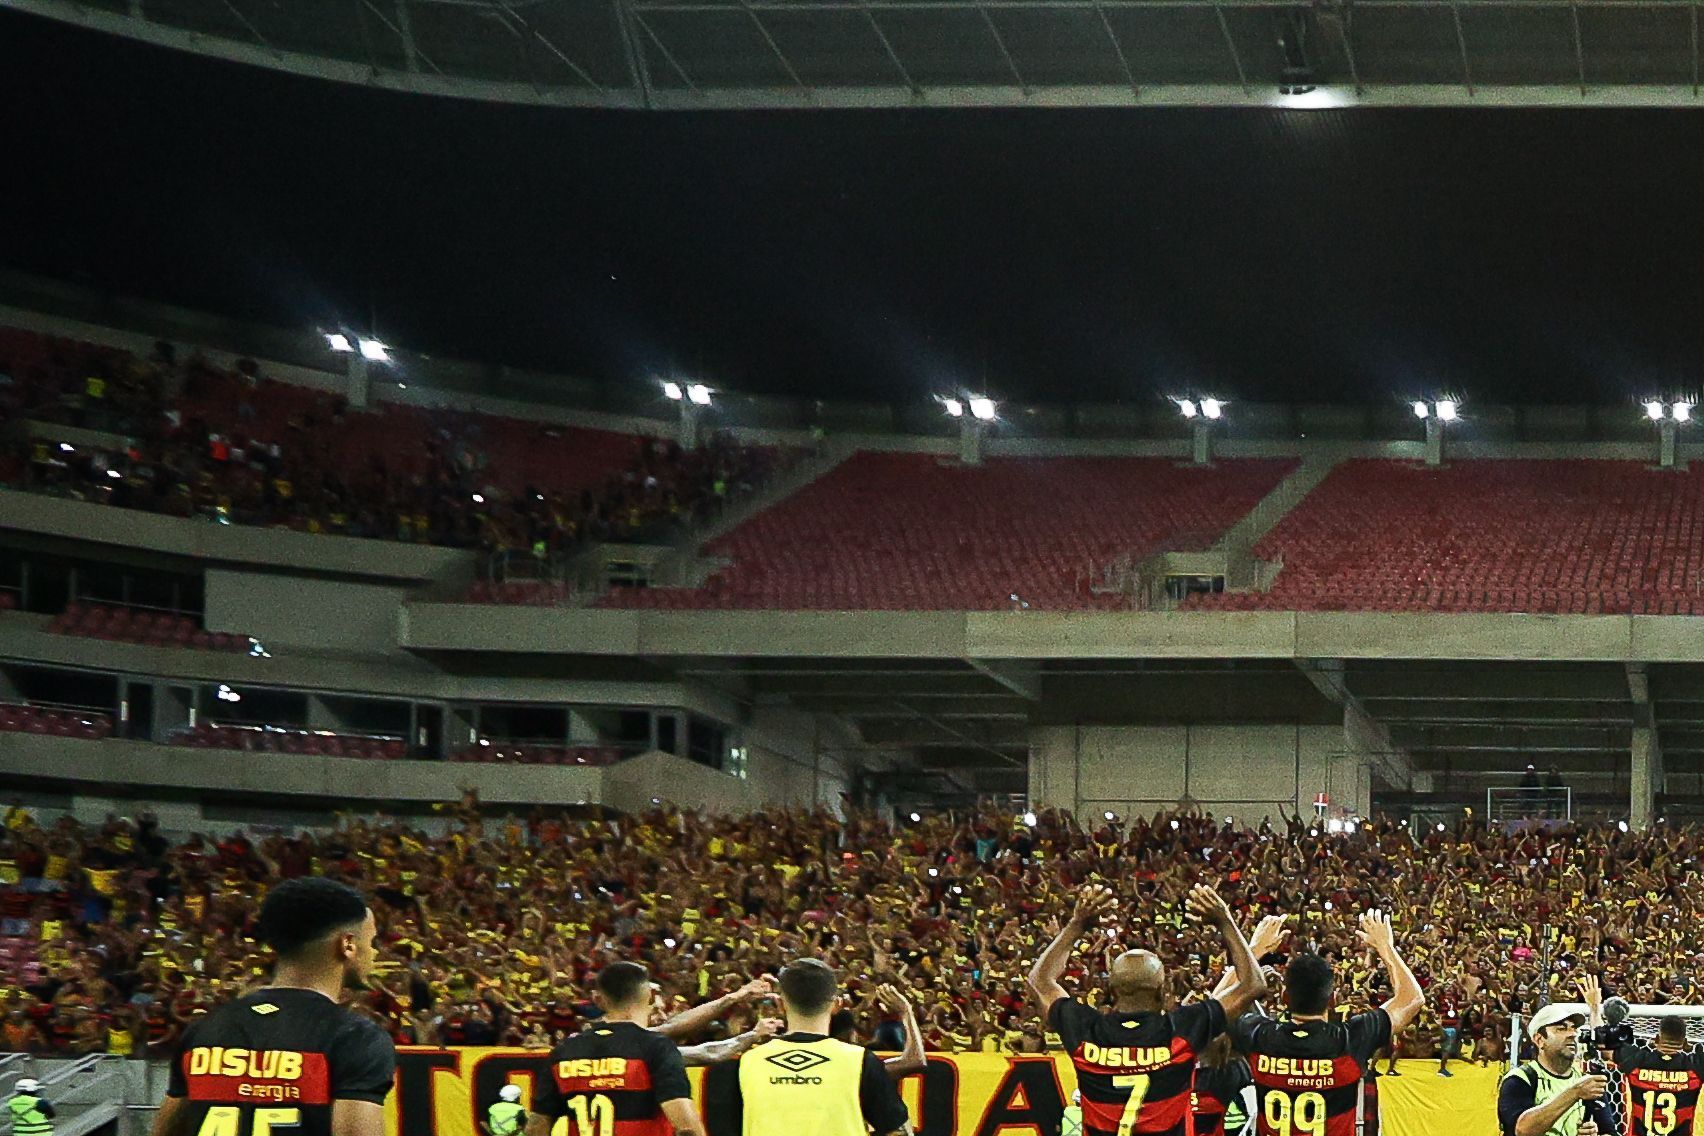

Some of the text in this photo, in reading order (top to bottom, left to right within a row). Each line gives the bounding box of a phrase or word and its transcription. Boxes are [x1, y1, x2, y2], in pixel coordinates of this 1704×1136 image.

[1084, 1042, 1171, 1067] DISLUB
[1258, 1055, 1334, 1076] DISLUB
[770, 1074, 822, 1085] umbro
[1287, 1077, 1334, 1089] energia
[1638, 1069, 1688, 1083] DISLUB
[1643, 1091, 1677, 1135] 13
